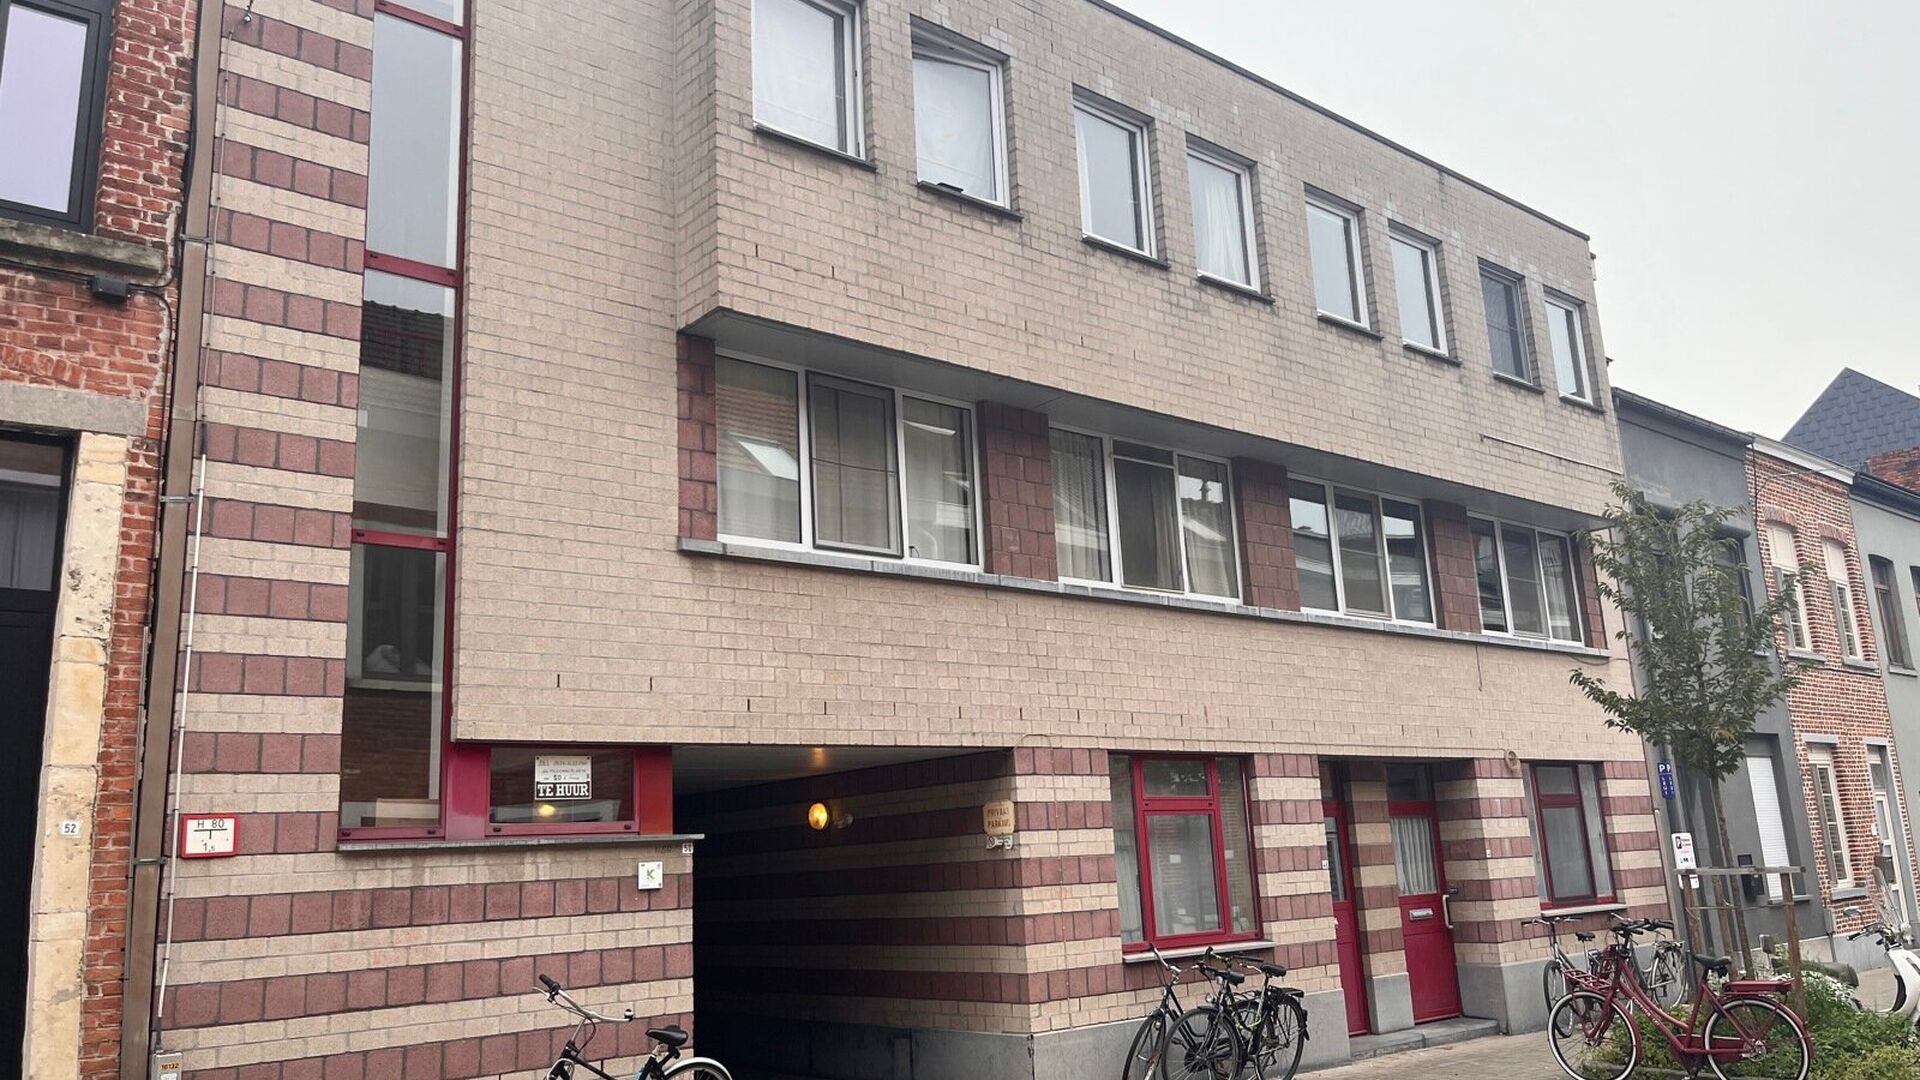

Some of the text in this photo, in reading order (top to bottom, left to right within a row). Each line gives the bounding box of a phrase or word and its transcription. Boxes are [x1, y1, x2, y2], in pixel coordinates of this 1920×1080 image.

[537, 783, 589, 797] TE HUUR
[64, 823, 76, 834] 52
[197, 819, 225, 829] H 80
[646, 868, 655, 880] K
